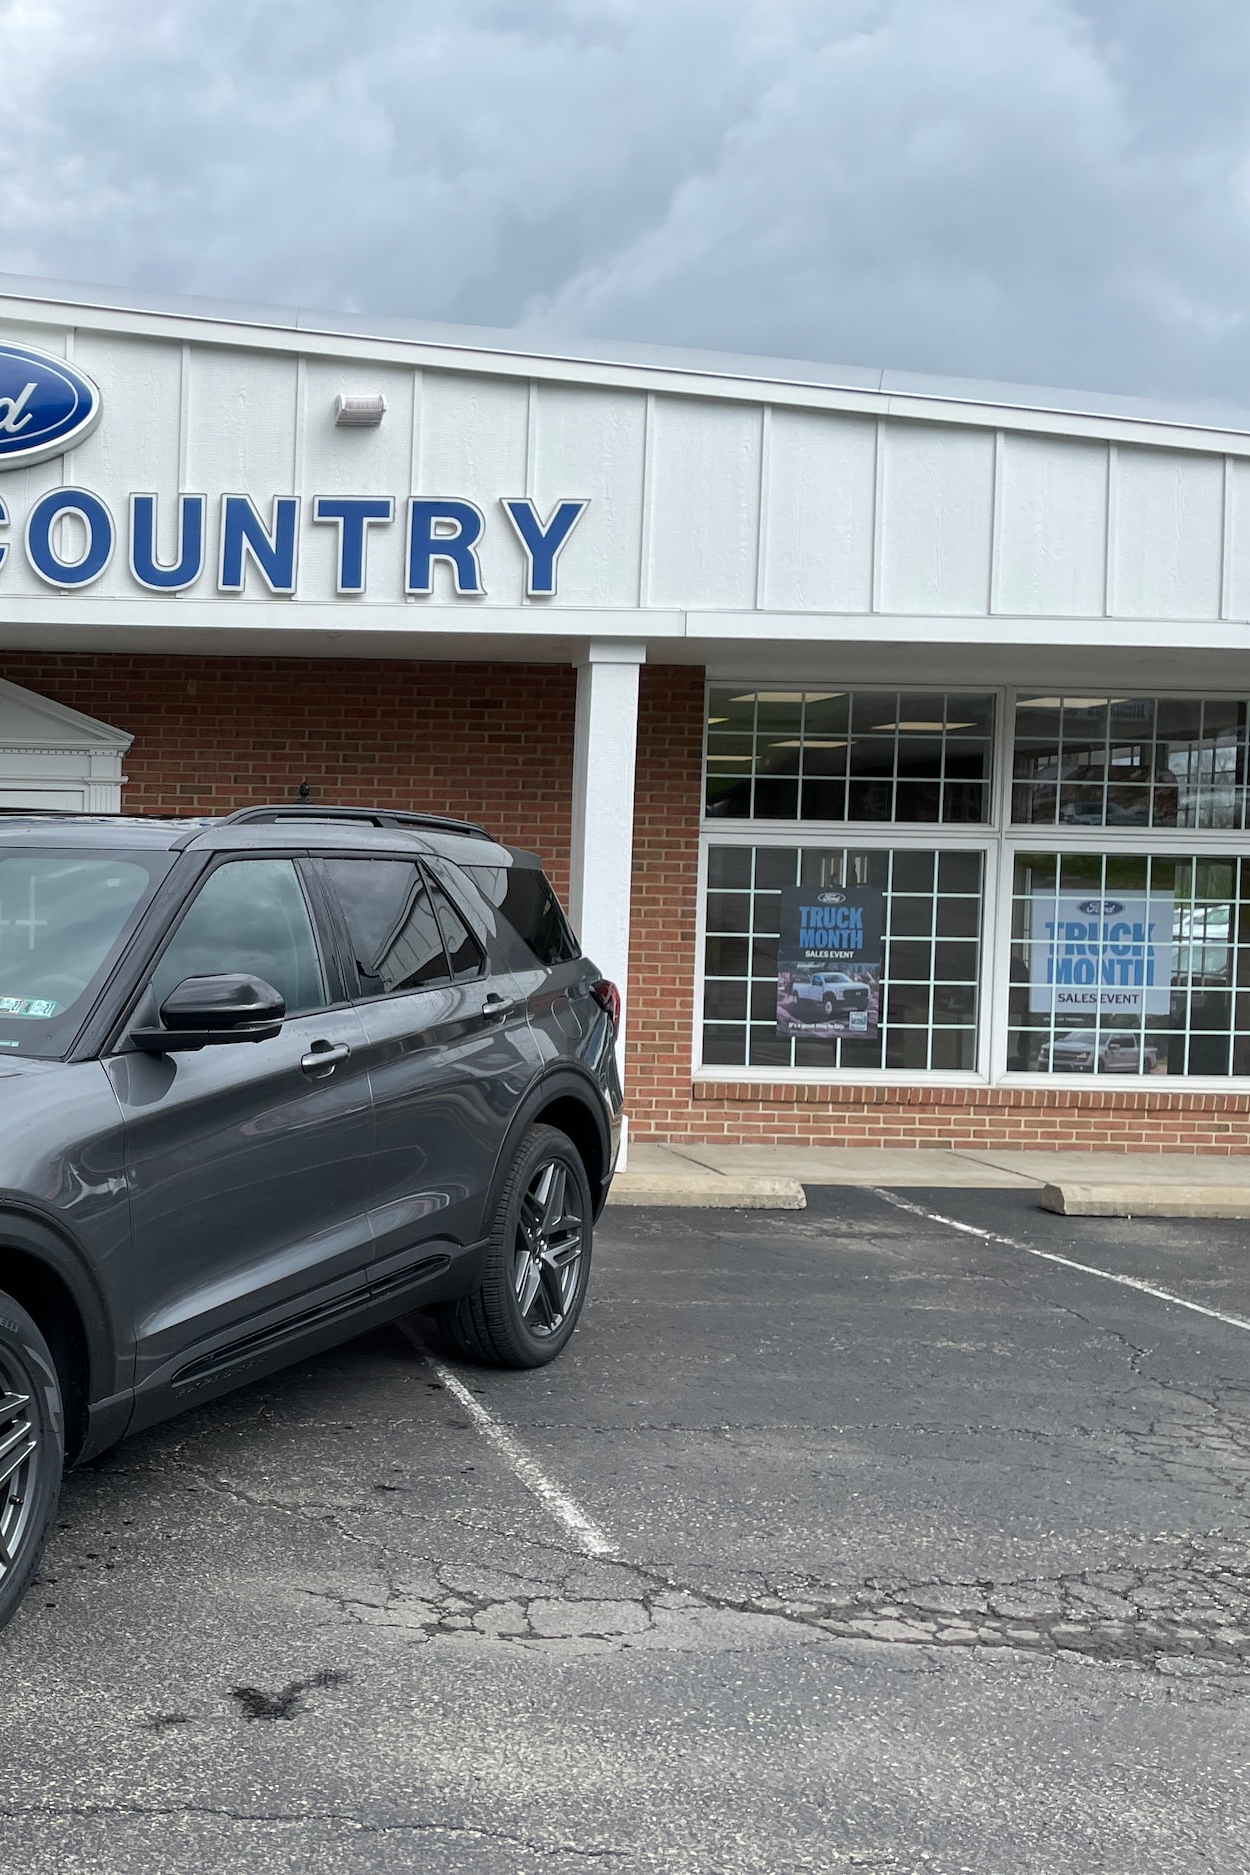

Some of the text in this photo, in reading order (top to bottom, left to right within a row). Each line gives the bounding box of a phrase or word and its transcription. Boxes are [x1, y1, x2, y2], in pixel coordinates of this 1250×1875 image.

[823, 893, 841, 902] Ford
[799, 906, 864, 929] TRUCK
[799, 928, 863, 949] MONTH
[1045, 921, 1155, 957] TRUCK
[805, 950, 854, 959] SALES EVENT
[1047, 957, 1154, 986] MONTH
[1058, 993, 1140, 1004] SALES EVENT
